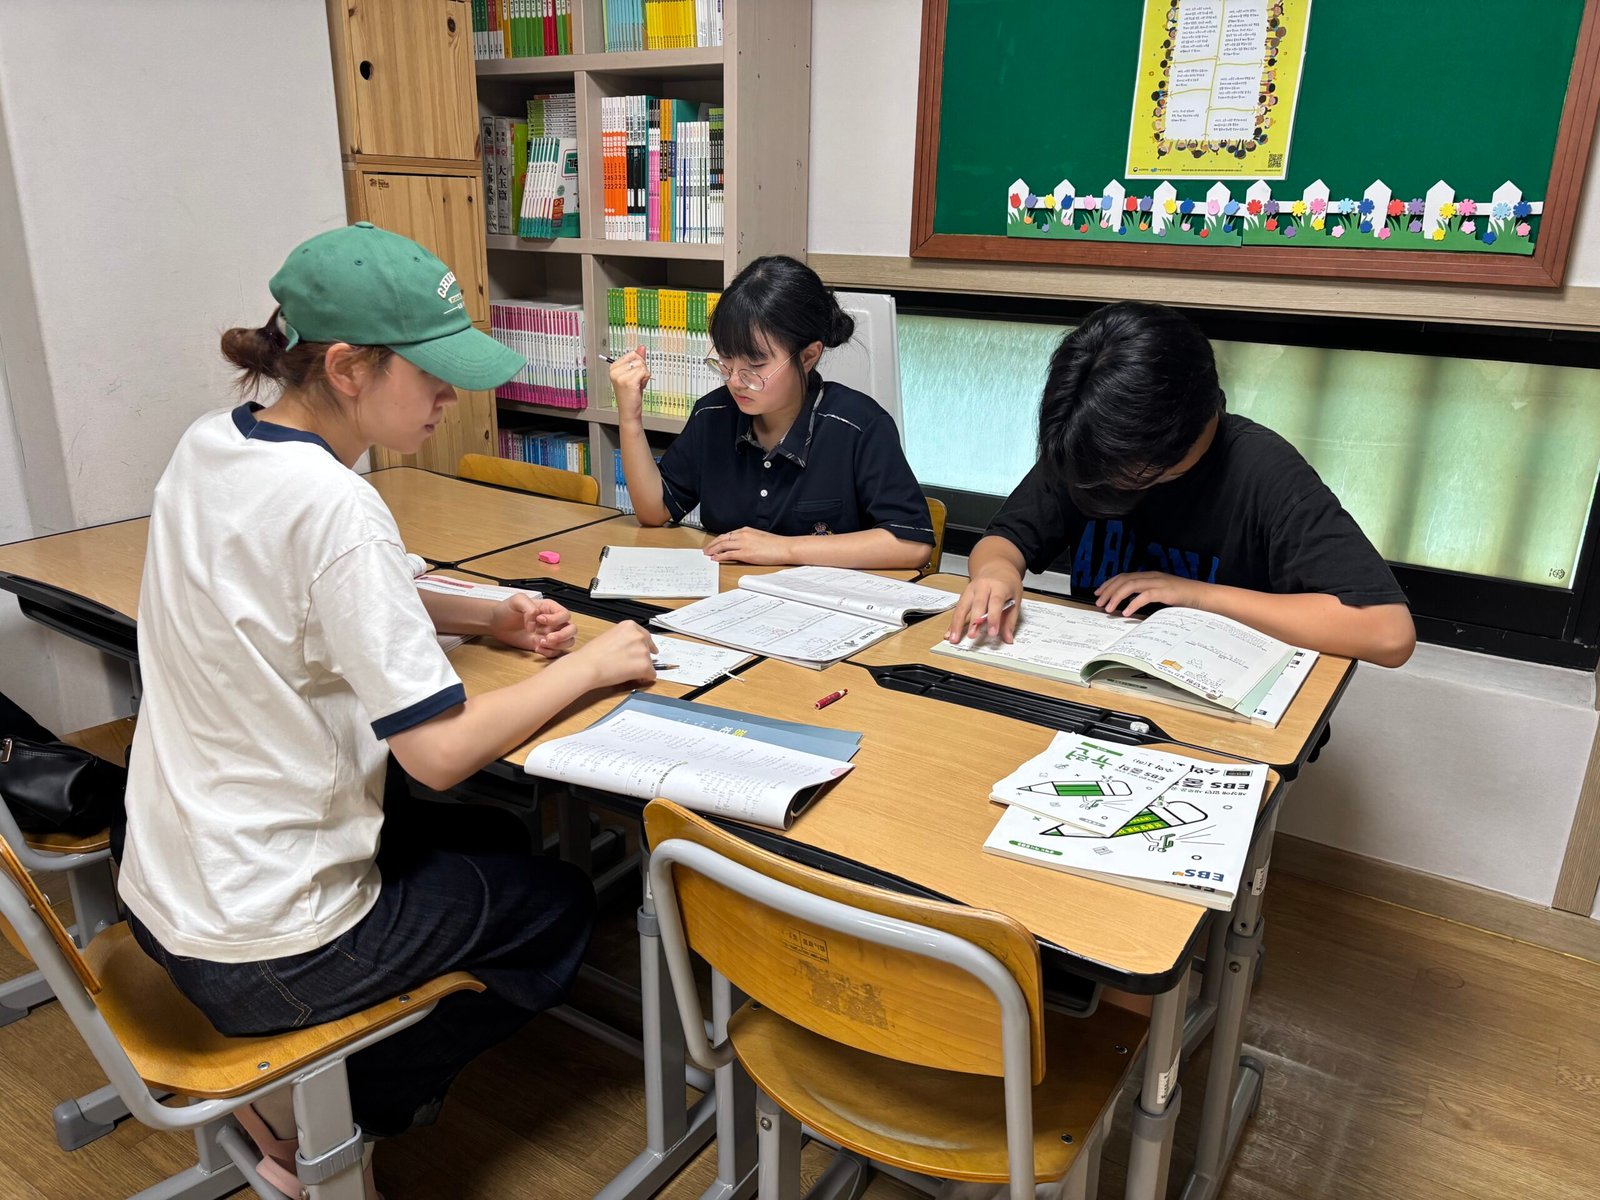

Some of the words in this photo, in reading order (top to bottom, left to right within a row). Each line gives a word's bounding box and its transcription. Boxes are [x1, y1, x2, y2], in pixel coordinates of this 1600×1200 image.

[1144, 771, 1166, 781] EBS
[1210, 781, 1250, 791] EBS
[1184, 869, 1225, 882] EBS
